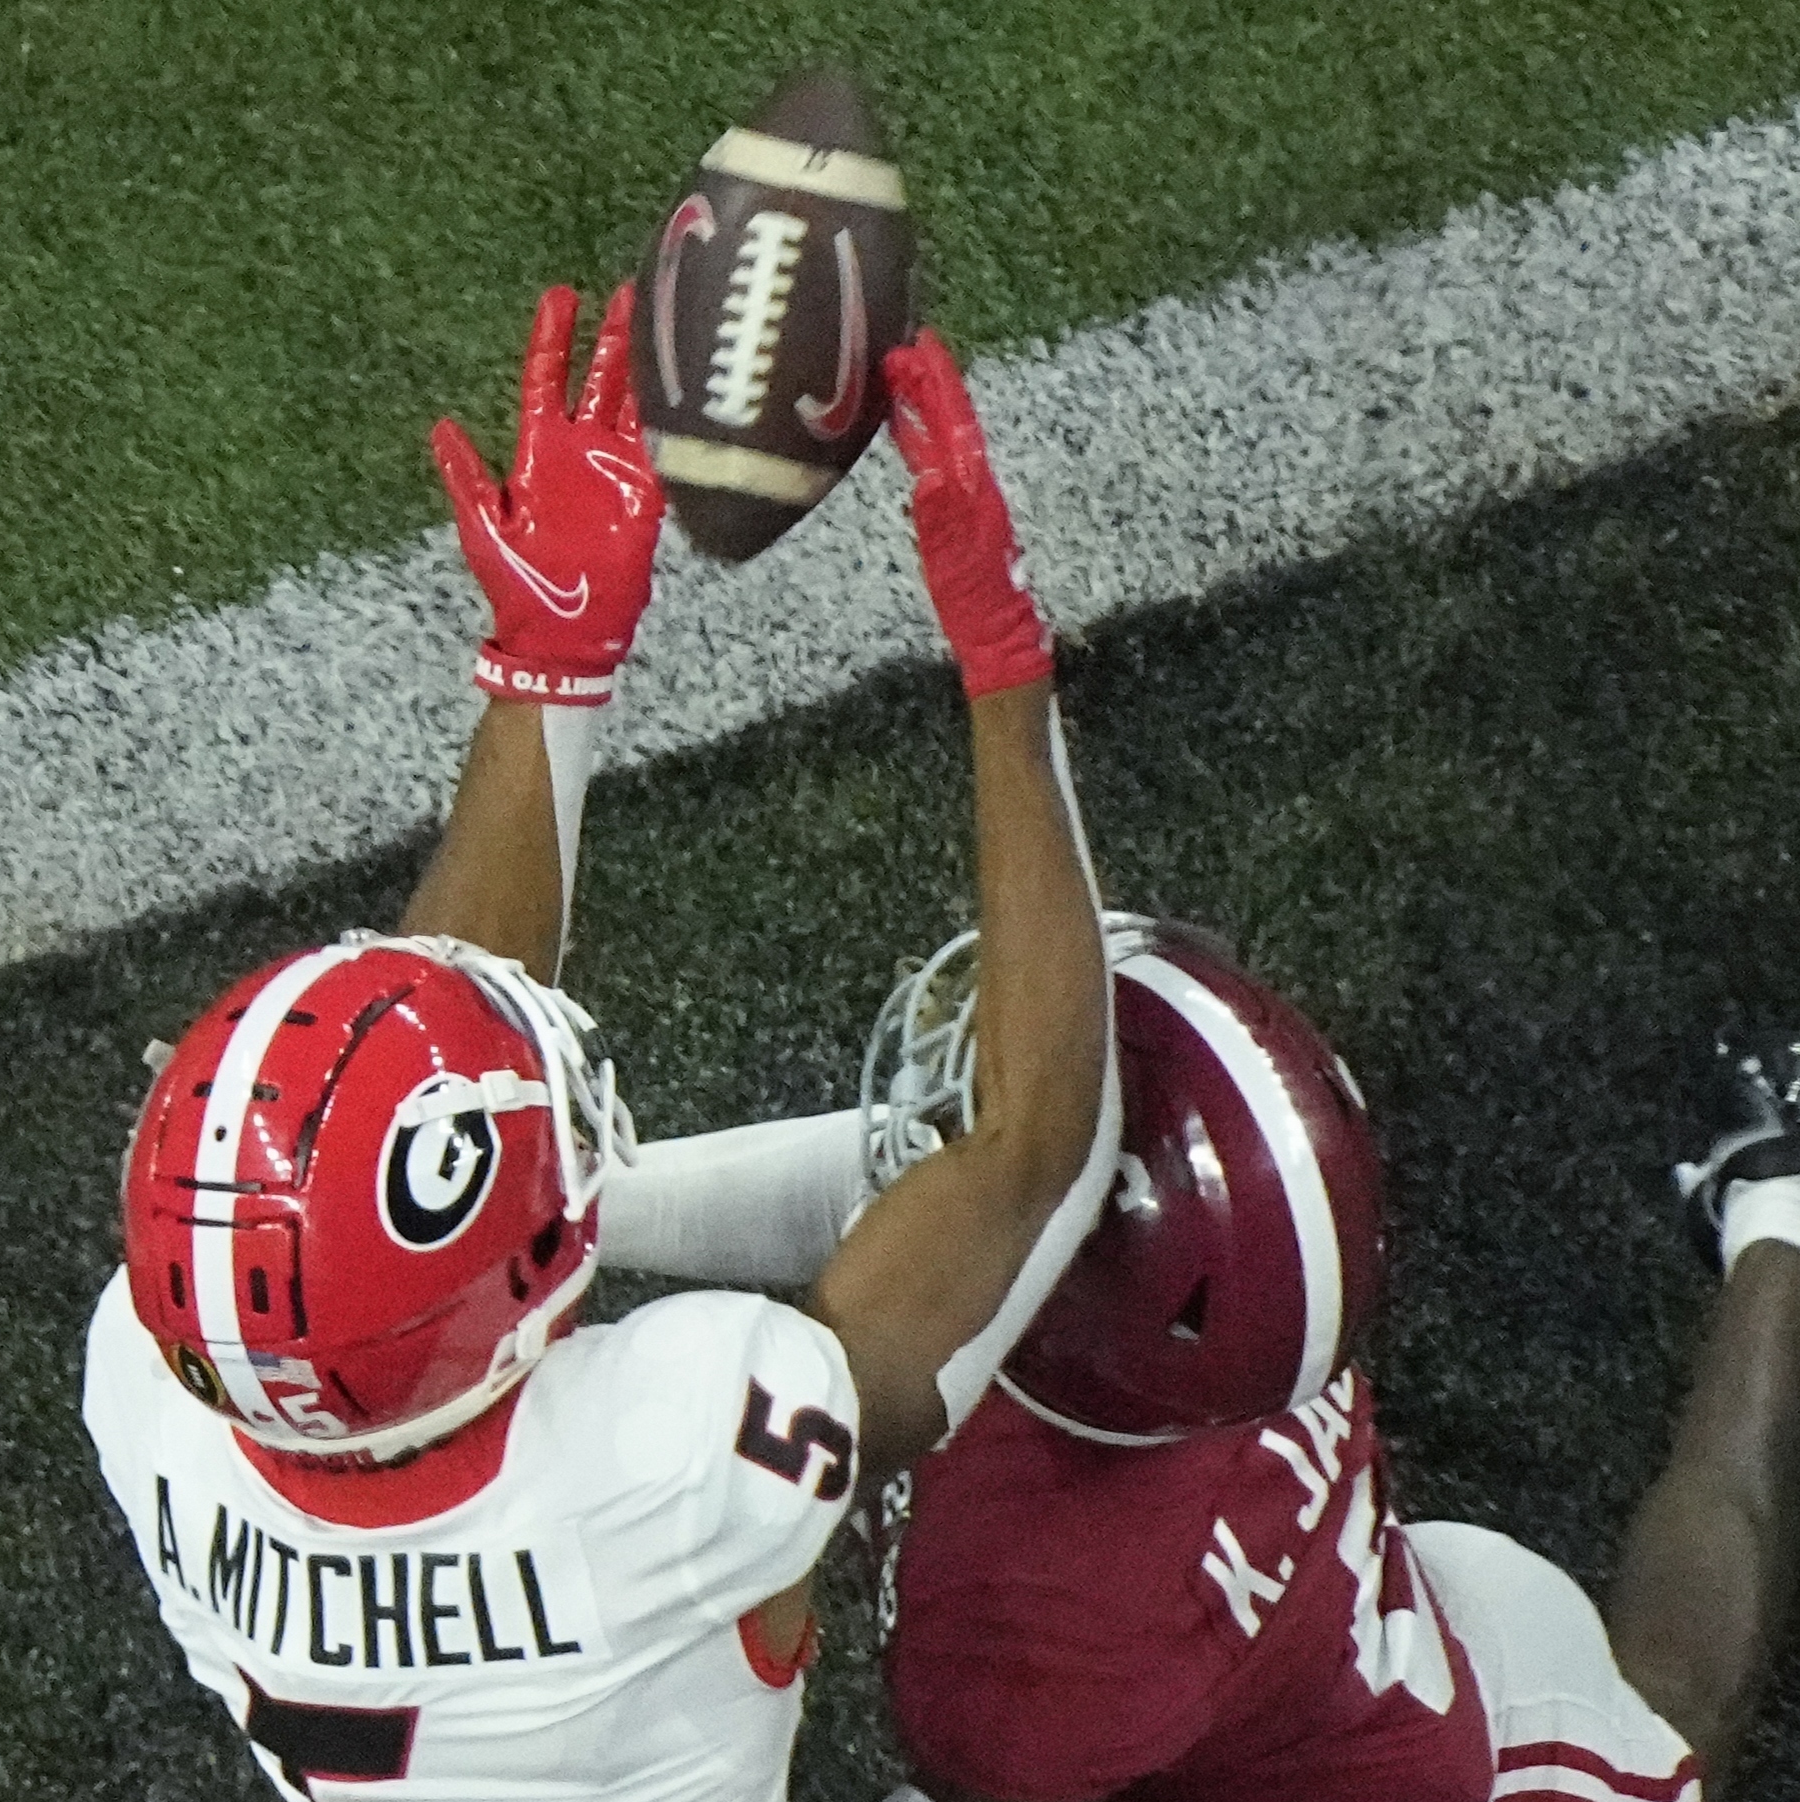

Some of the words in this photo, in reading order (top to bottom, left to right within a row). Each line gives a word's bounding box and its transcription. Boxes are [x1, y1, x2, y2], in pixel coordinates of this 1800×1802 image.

[512, 670, 550, 694] TO
[389, 1083, 495, 1232] G
[278, 1392, 351, 1439] 5
[734, 1374, 853, 1501] 5
[1201, 1517, 1296, 1639] K.
